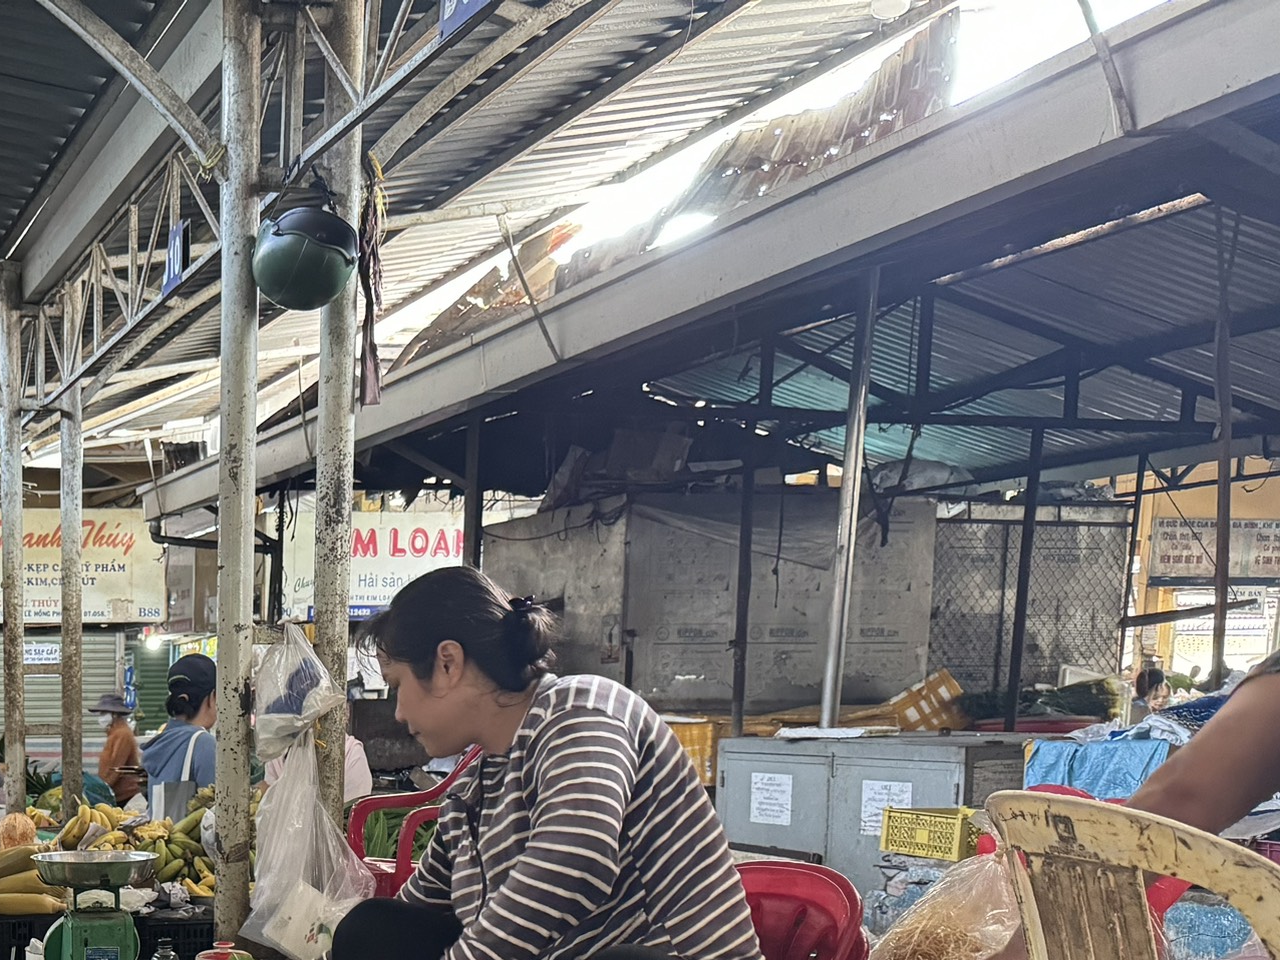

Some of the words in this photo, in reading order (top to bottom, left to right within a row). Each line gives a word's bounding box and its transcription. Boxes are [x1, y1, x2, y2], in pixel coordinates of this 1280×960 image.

[81, 574, 96, 586] ÚT
[358, 572, 378, 588] Hải
[138, 607, 161, 618] B88
